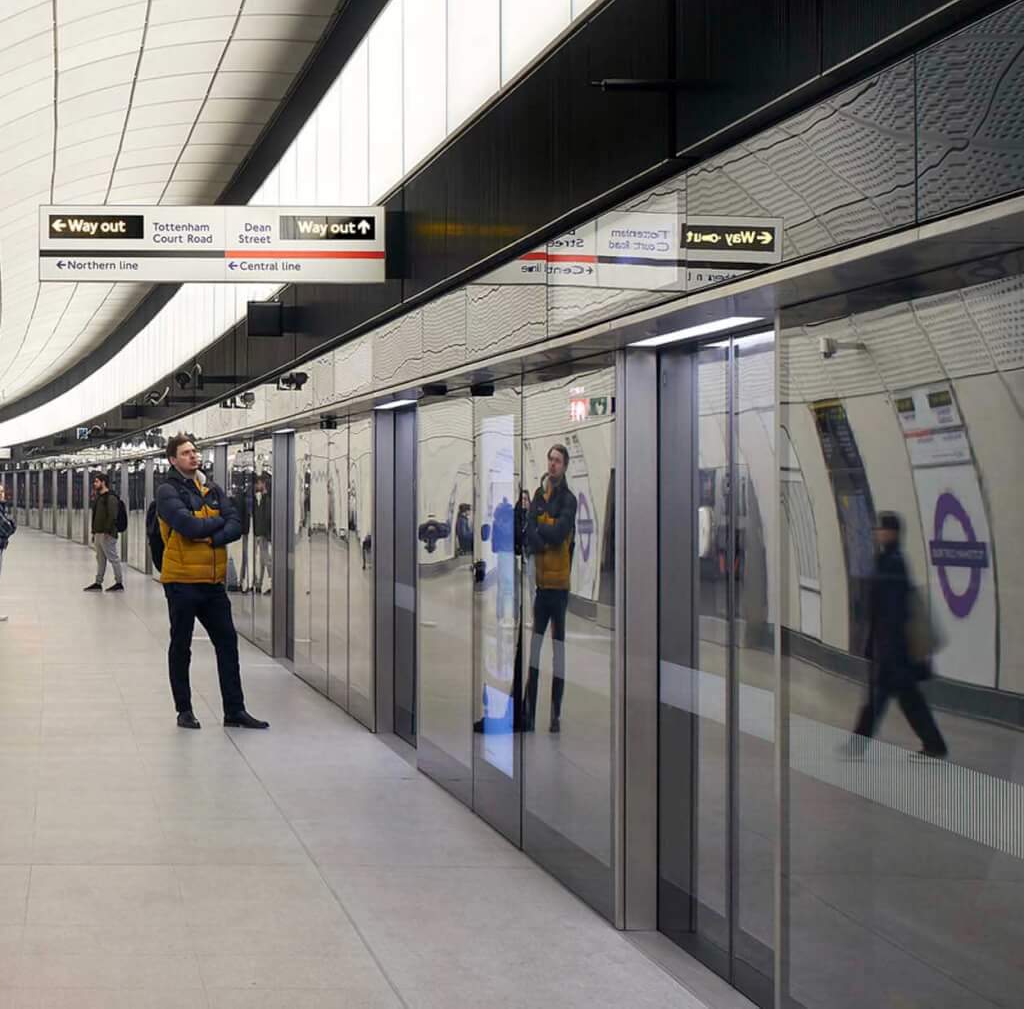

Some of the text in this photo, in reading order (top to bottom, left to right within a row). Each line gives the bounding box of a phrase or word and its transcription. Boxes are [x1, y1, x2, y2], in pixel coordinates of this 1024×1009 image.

[68, 219, 126, 235] Way out
[153, 222, 210, 232] Tottenham
[244, 223, 272, 232] Dean
[298, 220, 356, 236] Way out
[153, 234, 213, 244] Court Road
[238, 234, 271, 244] Street
[67, 260, 138, 271] Northern line
[240, 261, 301, 271] Central line
